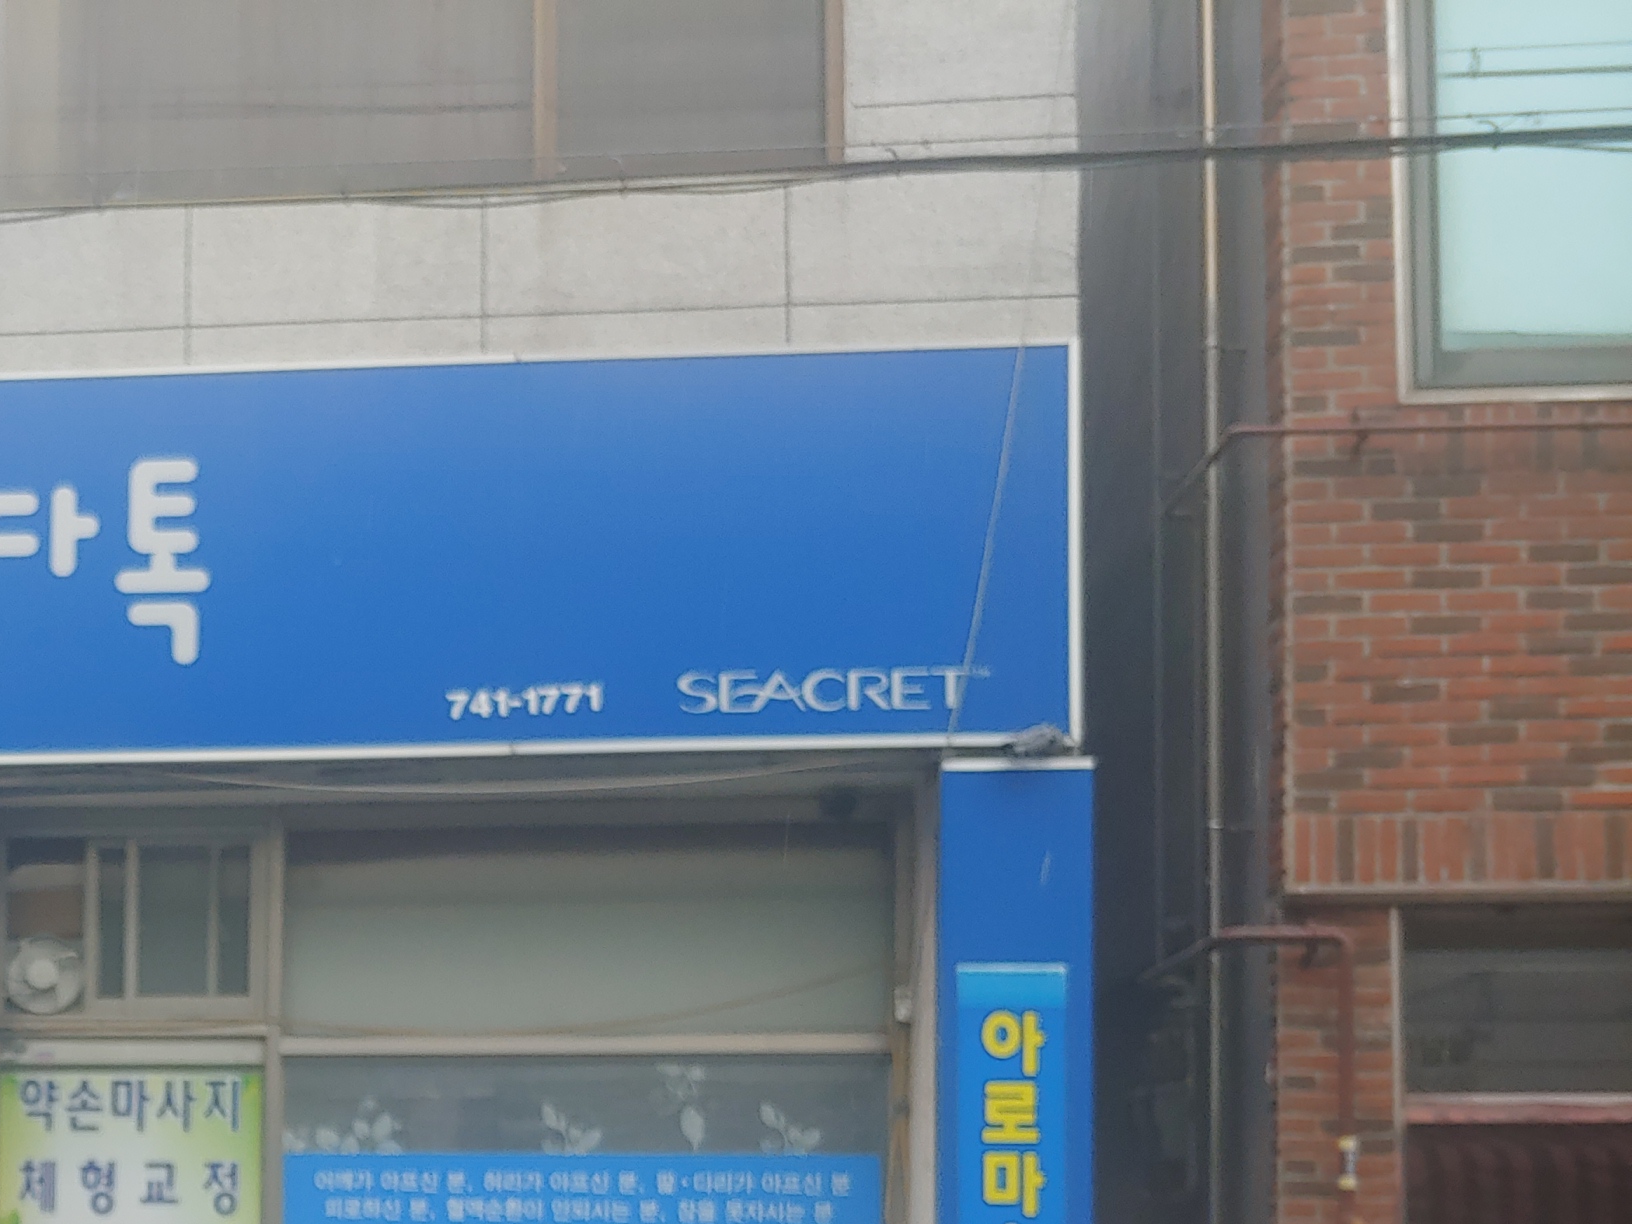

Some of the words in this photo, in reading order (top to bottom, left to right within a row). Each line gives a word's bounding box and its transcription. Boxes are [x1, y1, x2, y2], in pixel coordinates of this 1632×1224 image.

[445, 682, 605, 721] 741-1771
[676, 667, 970, 714] SEACRET
[19, 1079, 241, 1133] 약손마사지
